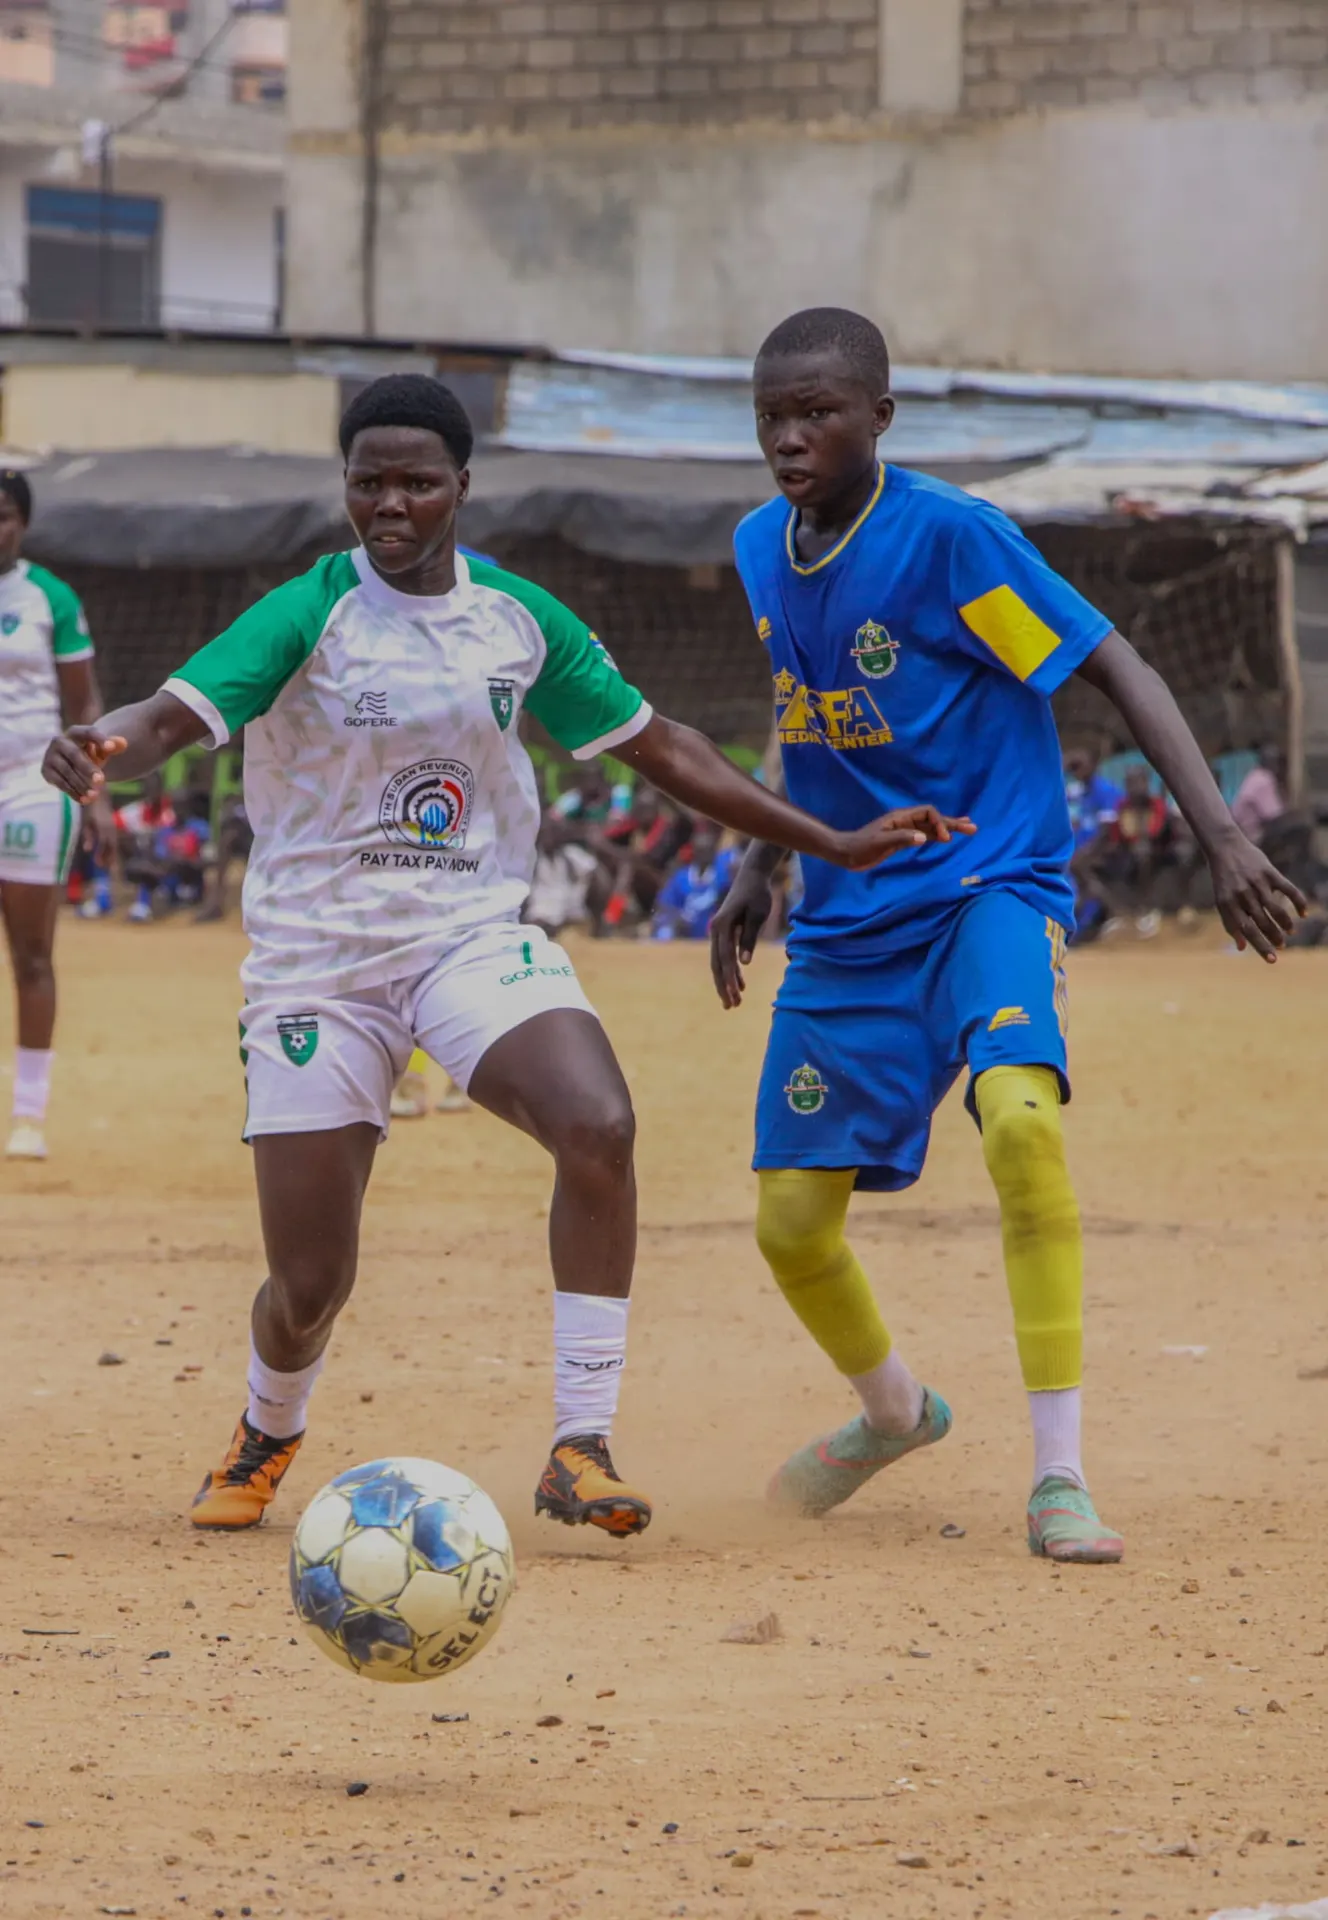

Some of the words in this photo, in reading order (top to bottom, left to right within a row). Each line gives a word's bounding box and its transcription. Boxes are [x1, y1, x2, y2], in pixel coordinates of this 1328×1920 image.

[344, 717, 397, 727] GOFERE
[387, 768, 417, 800] SUDAN
[419, 762, 468, 779] REVENUE
[4, 821, 35, 849] 10
[361, 853, 390, 867] PAY
[393, 854, 421, 868] TAX
[427, 1566, 503, 1670] SELECT
